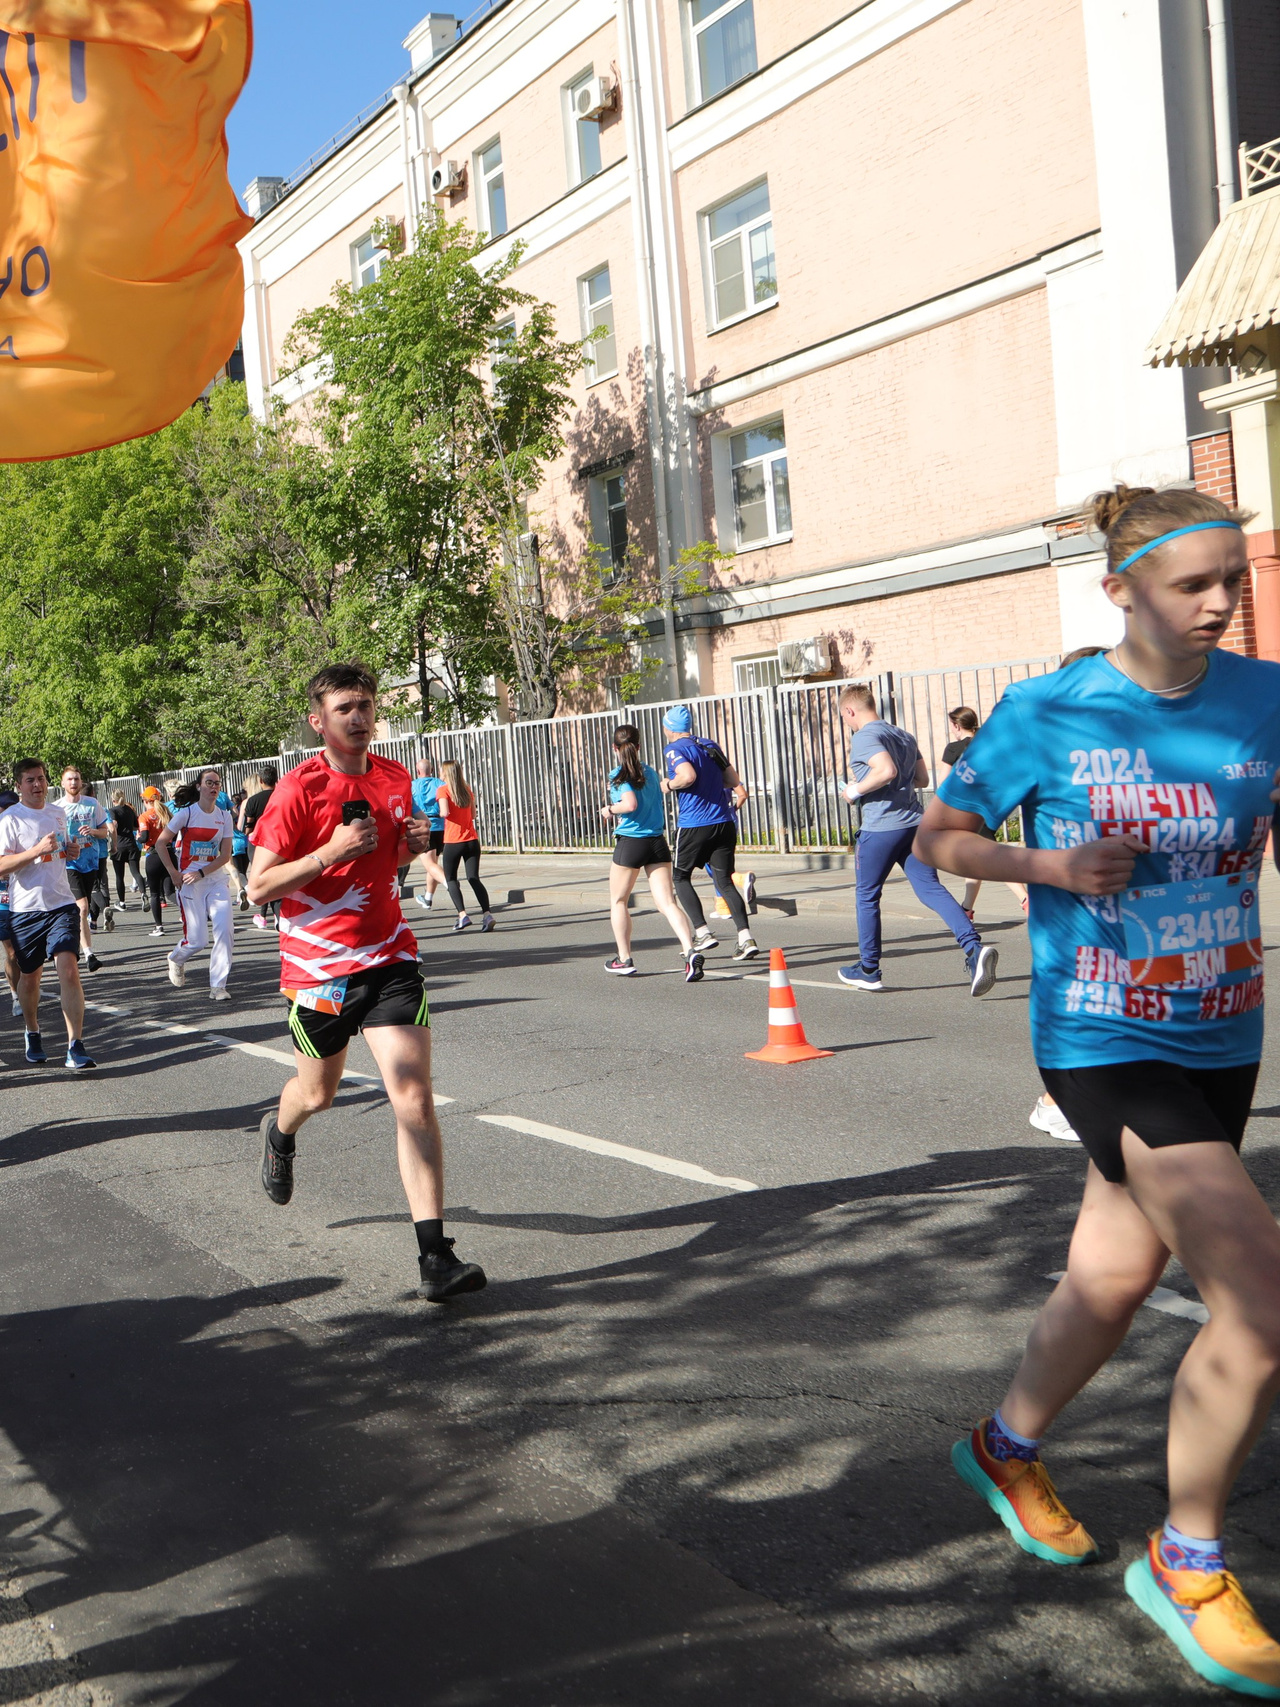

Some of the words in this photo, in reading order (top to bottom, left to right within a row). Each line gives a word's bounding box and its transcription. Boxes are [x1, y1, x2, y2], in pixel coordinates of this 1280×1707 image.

[1069, 748, 1154, 785] 2024
[1089, 783, 1219, 820] #МЕЧТА
[1158, 906, 1240, 950] 23412
[1065, 980, 1174, 1021] #ЗАБЕГ
